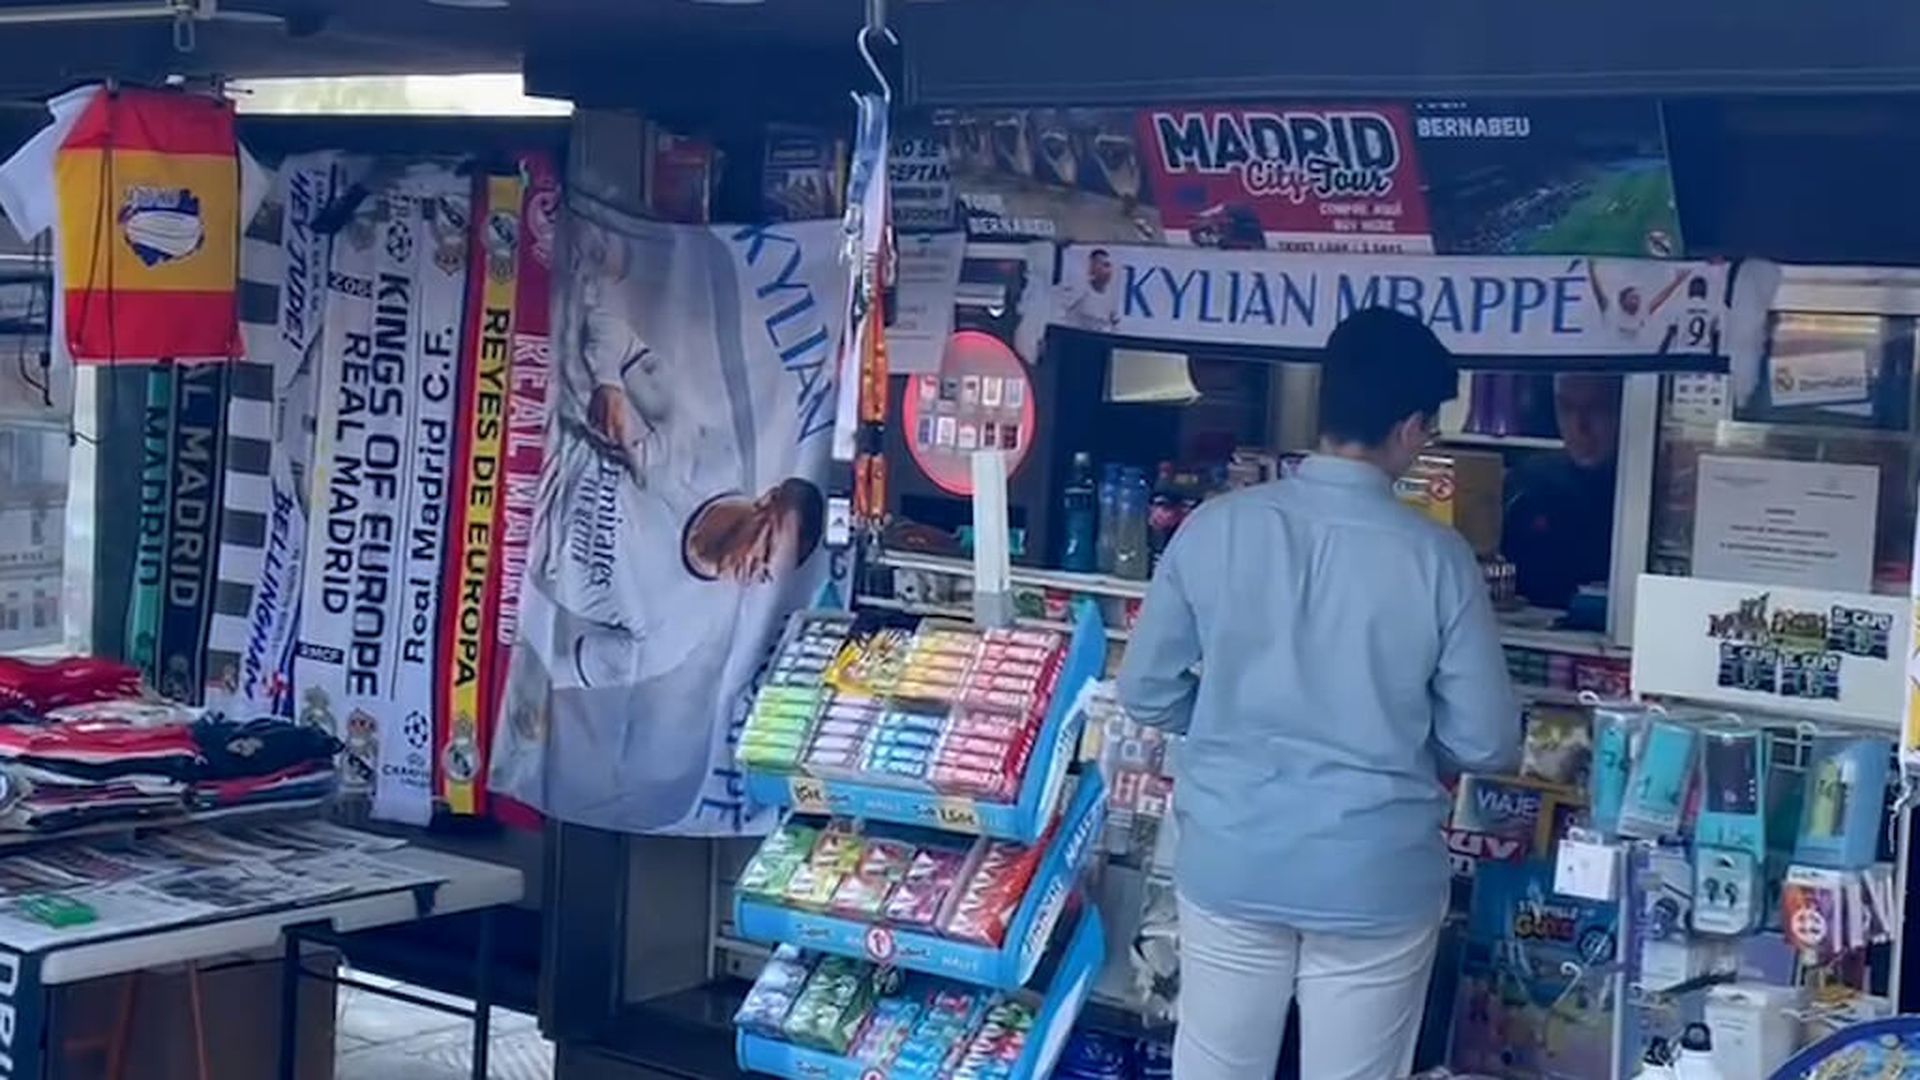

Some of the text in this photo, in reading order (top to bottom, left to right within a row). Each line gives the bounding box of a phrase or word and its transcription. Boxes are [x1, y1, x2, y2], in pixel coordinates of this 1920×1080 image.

[889, 163, 951, 181] CEPTAN
[1155, 112, 1398, 173] MADRID
[1244, 153, 1392, 202] City Tour
[1418, 117, 1530, 138] BERNABEU
[732, 223, 837, 443] KYLIAN
[1122, 260, 1588, 335] KYLIAN MBAPPÉ
[1688, 316, 1707, 347] 9
[138, 405, 170, 588] MADRID
[169, 362, 213, 609] AL MADRID
[322, 332, 371, 615] REAL MADRID
[346, 273, 410, 698] KINGS OF EUROPE
[403, 327, 454, 664] Real Madrid C.F.
[454, 308, 511, 688] REYES DE EUROPA
[497, 333, 551, 648] REAL MADRID
[589, 467, 622, 590] Emirates
[1476, 786, 1539, 818] VIAJE
